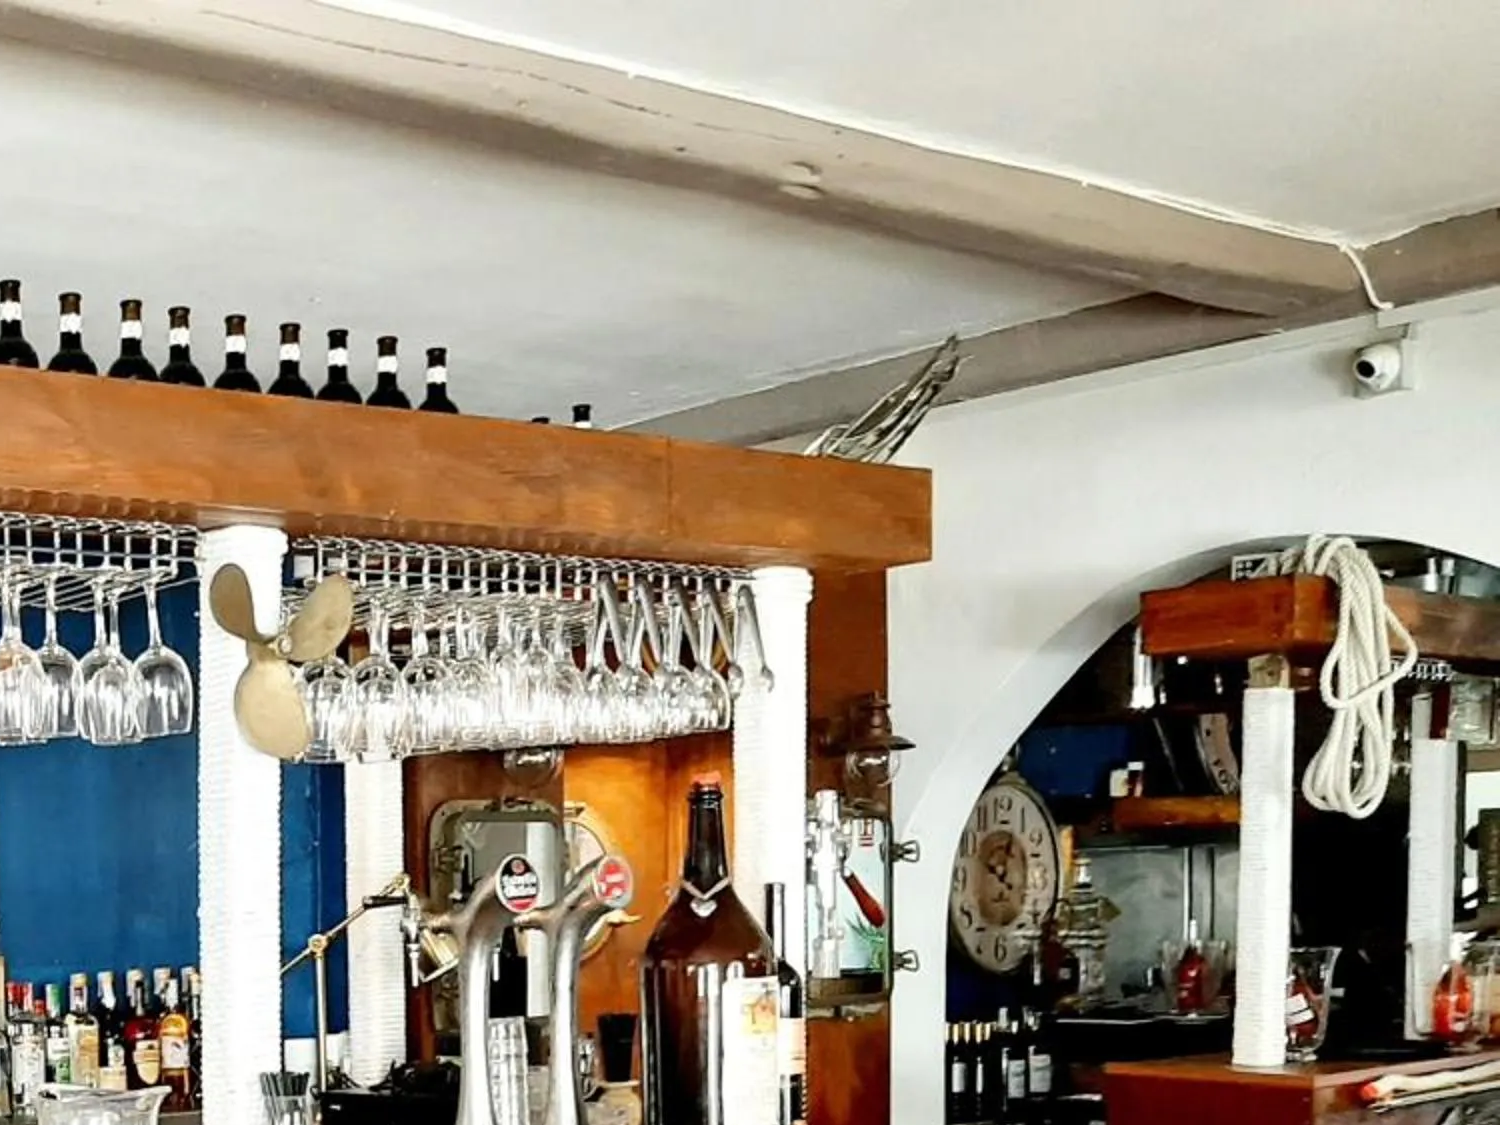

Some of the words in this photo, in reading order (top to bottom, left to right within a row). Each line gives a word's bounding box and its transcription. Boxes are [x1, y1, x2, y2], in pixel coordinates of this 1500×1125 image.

[977, 805, 988, 832] 11
[993, 798, 1013, 825] 12
[994, 935, 1007, 962] 6
